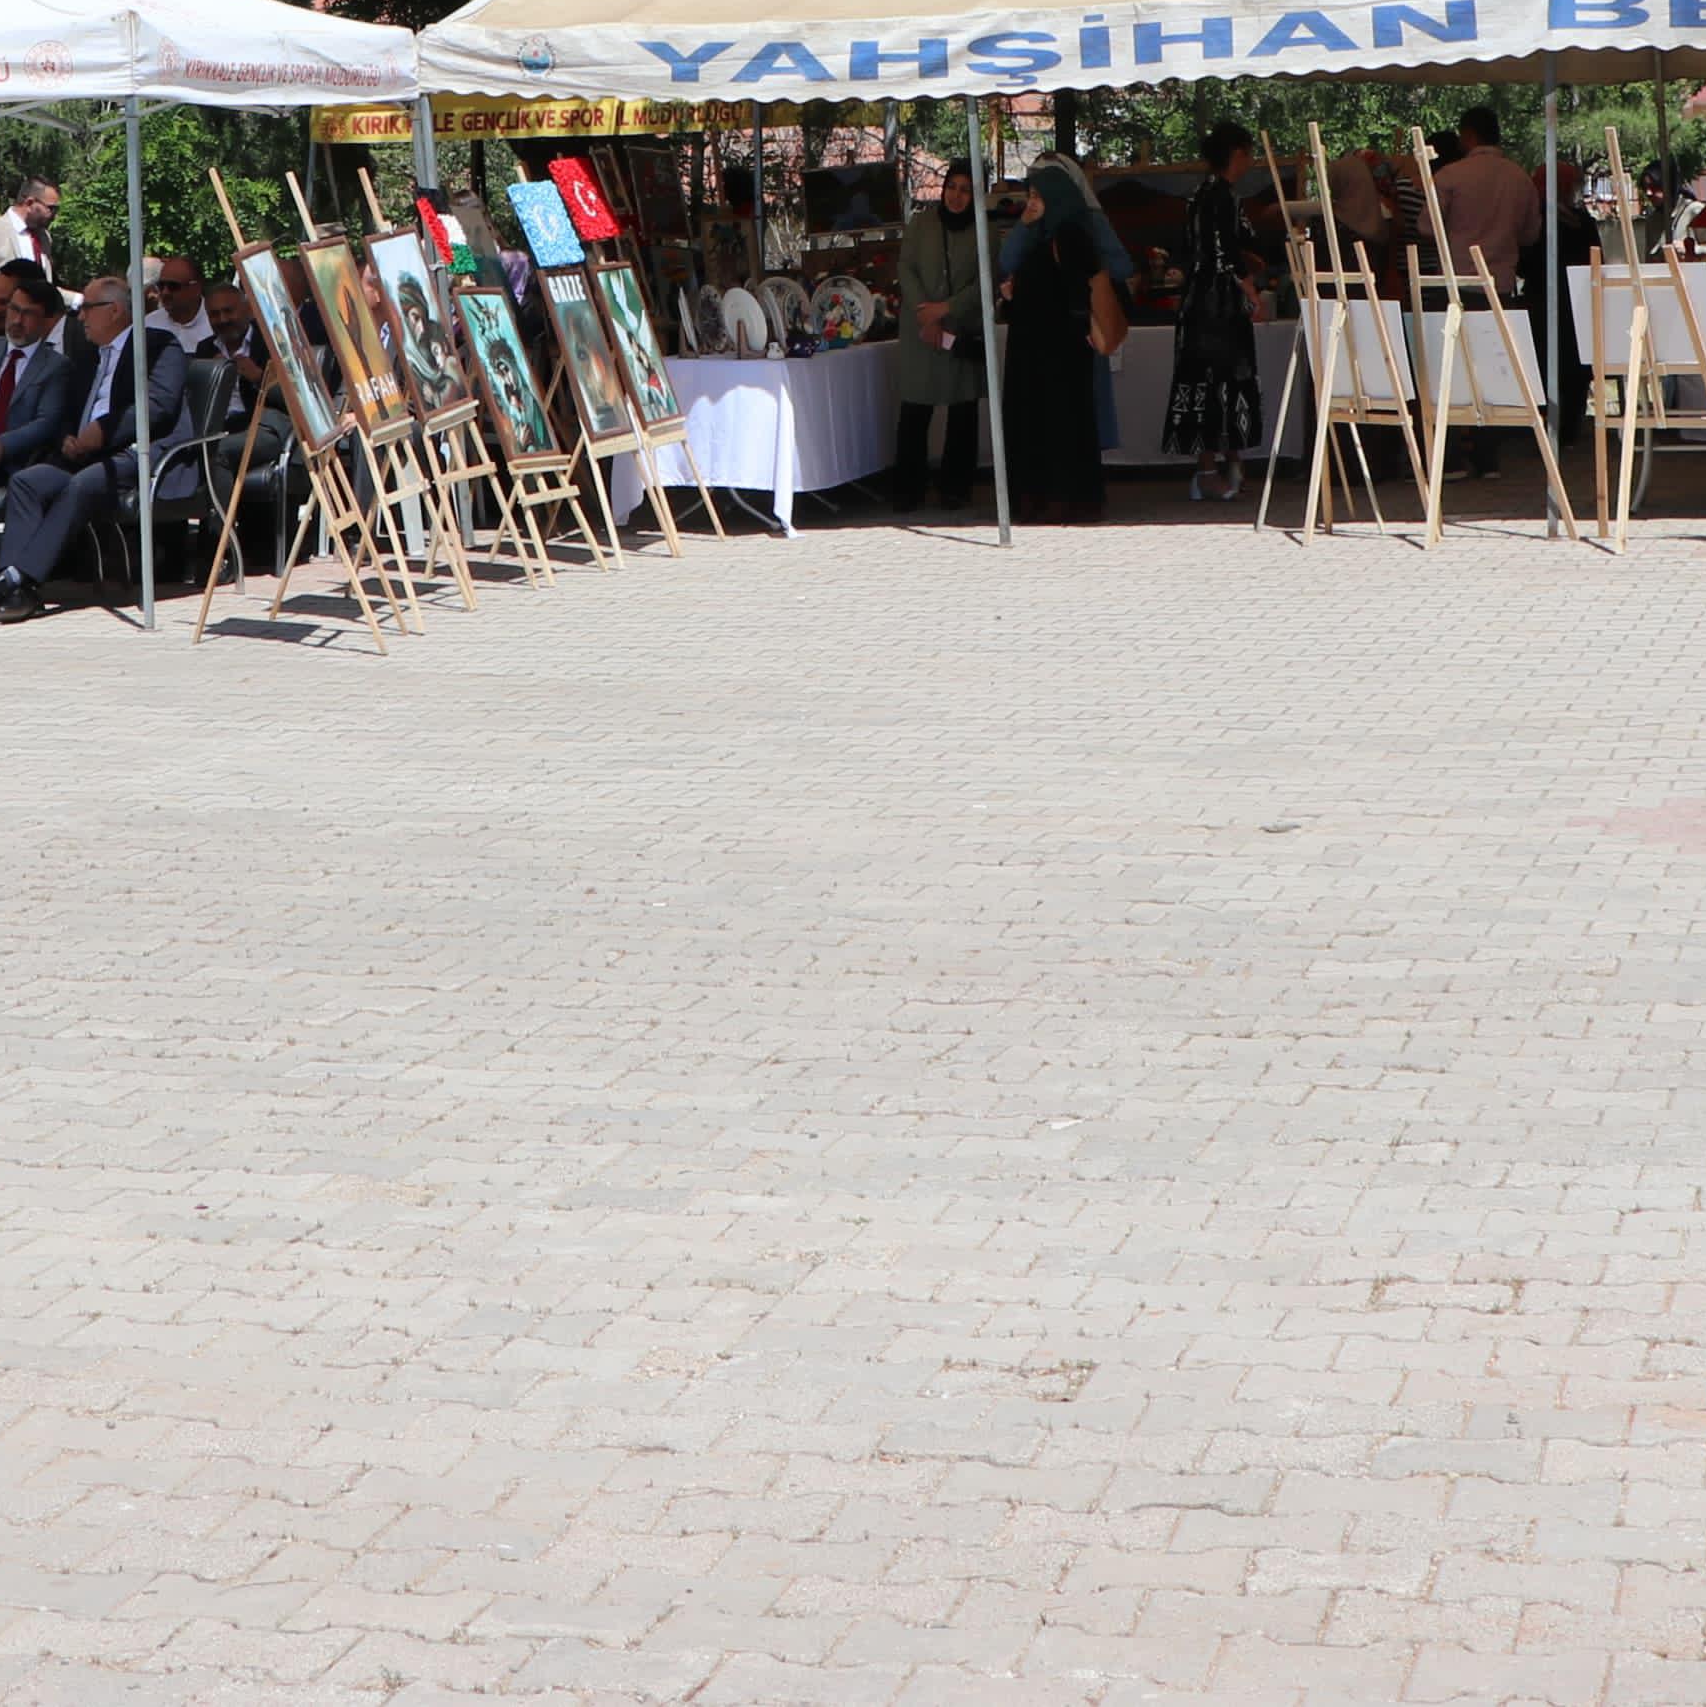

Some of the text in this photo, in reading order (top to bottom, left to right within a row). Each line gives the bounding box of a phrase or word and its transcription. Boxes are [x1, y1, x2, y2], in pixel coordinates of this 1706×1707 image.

[460, 105, 531, 135] GENÇLİK
[534, 108, 556, 128] VE
[559, 108, 605, 128] SPOR
